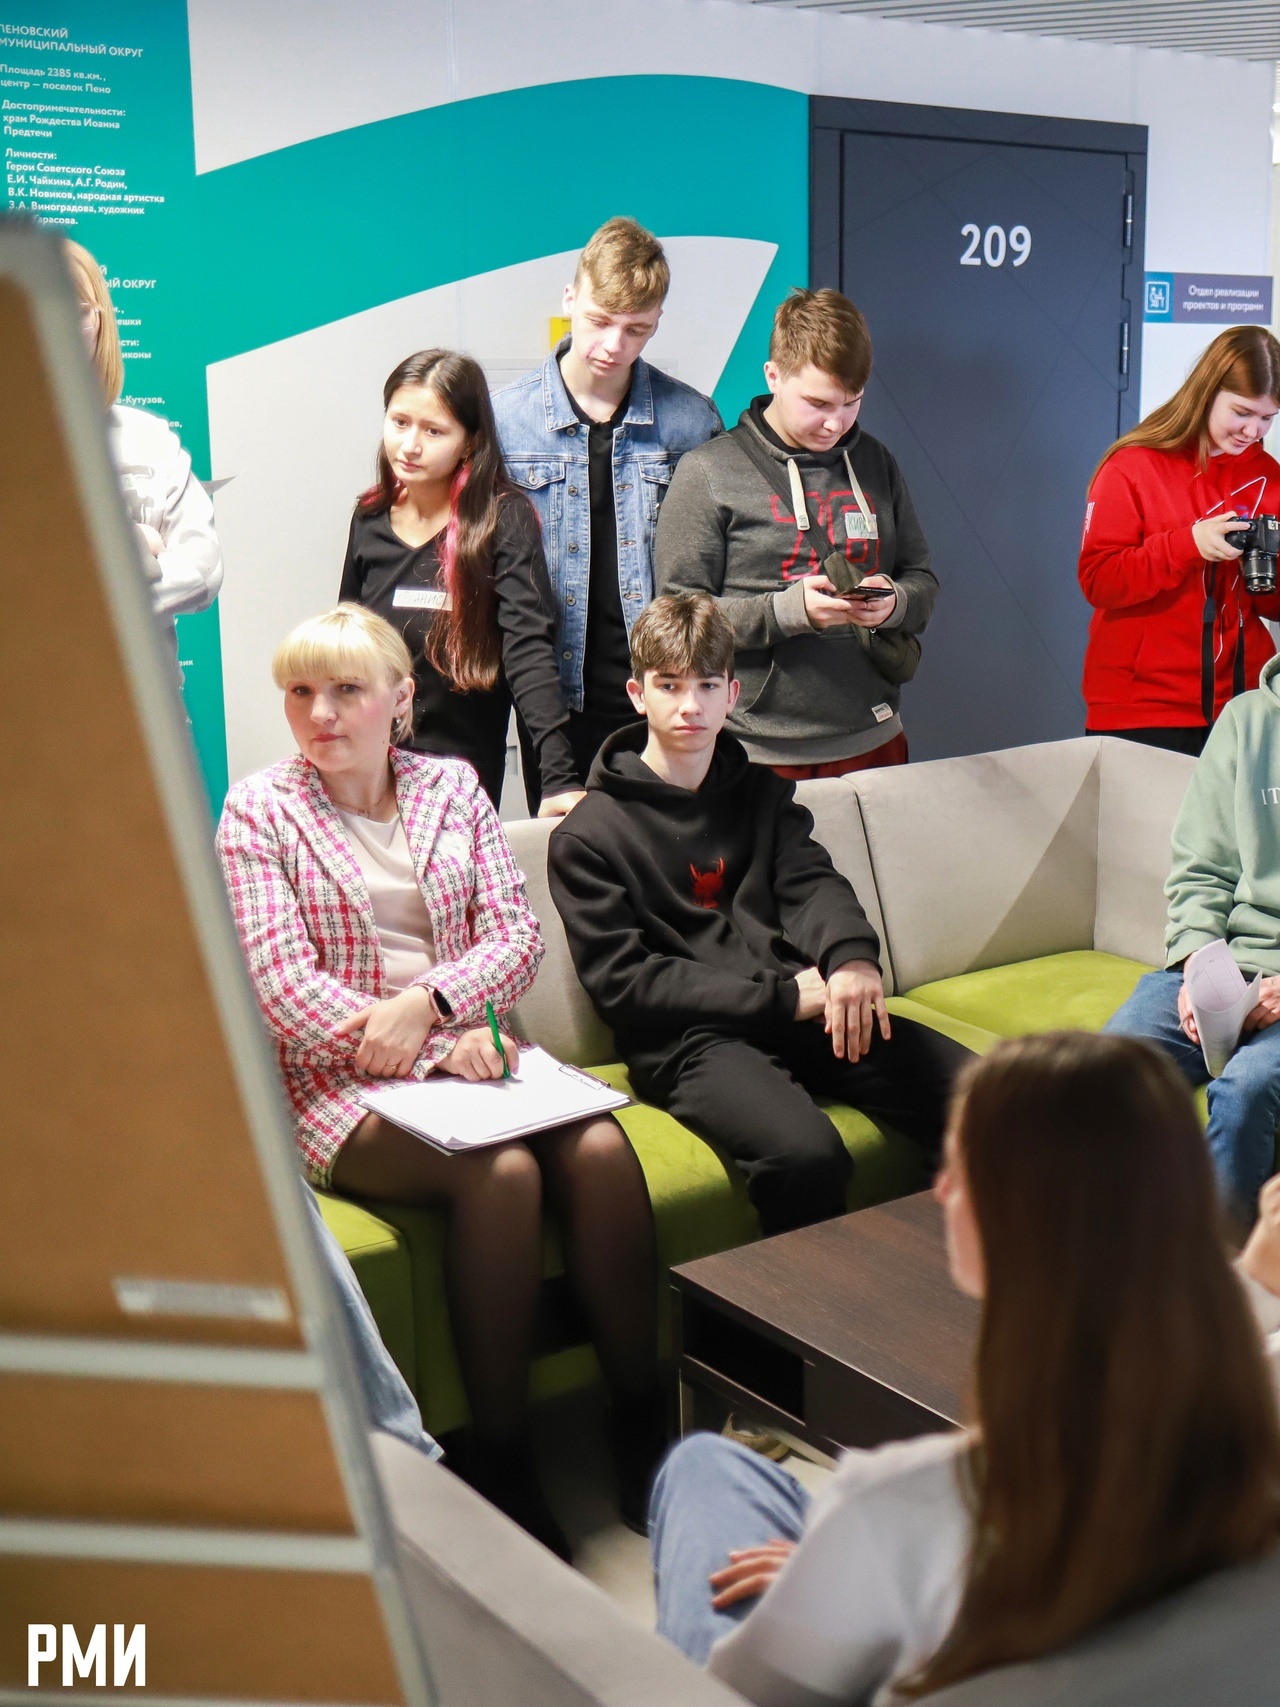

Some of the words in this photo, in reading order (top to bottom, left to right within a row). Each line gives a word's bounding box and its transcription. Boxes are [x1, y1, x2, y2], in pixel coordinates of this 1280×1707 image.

[0, 37, 106, 54] МУНИЦИПАЛЬНЫЙ
[109, 46, 143, 58] ОКРУГ
[0, 64, 45, 76] Площадь
[48, 68, 72, 78] 2385
[0, 79, 30, 89] центр
[43, 82, 83, 92] поселок
[86, 84, 111, 94] Пено
[2, 100, 126, 116] Достопримечательности:
[3, 114, 27, 124] храм
[30, 114, 81, 126] Рождества
[84, 118, 120, 129] Иоанна
[4, 126, 52, 138] Предтечи
[5, 148, 57, 160] Личности:
[6, 161, 34, 172] Герои
[37, 163, 92, 175] Советского
[94, 166, 125, 176] Союза
[7, 174, 28, 184] Е.И.
[30, 176, 74, 187] Чайкина,
[76, 178, 93, 187] А.Г.
[96, 180, 127, 190] Родин,
[8, 188, 28, 197] В.К.
[30, 189, 76, 200] Новиков,
[77, 192, 121, 202] народная
[124, 195, 165, 203] артистка
[9, 200, 29, 210] З.А.
[32, 201, 97, 214] Виноградова,
[98, 207, 145, 215] художник
[960, 224, 1032, 267] 209
[122, 279, 157, 289] ОКРУГ
[1188, 285, 1213, 296] Отдел
